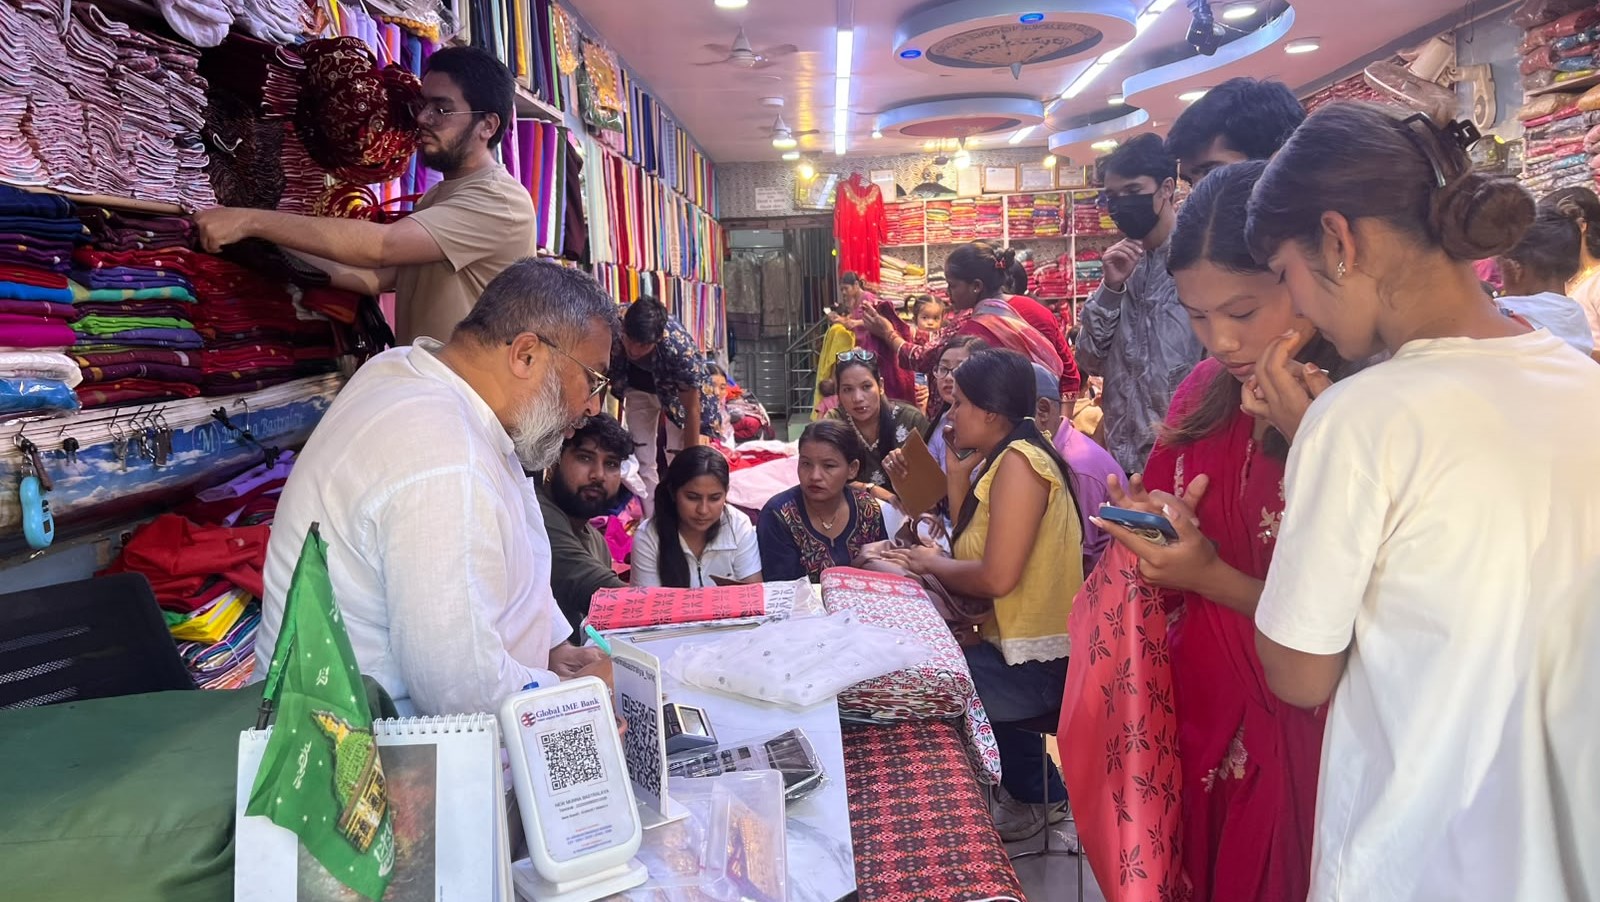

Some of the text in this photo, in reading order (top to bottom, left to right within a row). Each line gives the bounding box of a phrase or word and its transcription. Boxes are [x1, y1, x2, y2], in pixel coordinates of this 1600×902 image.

[535, 706, 561, 718] Global
[562, 702, 579, 712] IME
[580, 697, 600, 708] Bank
